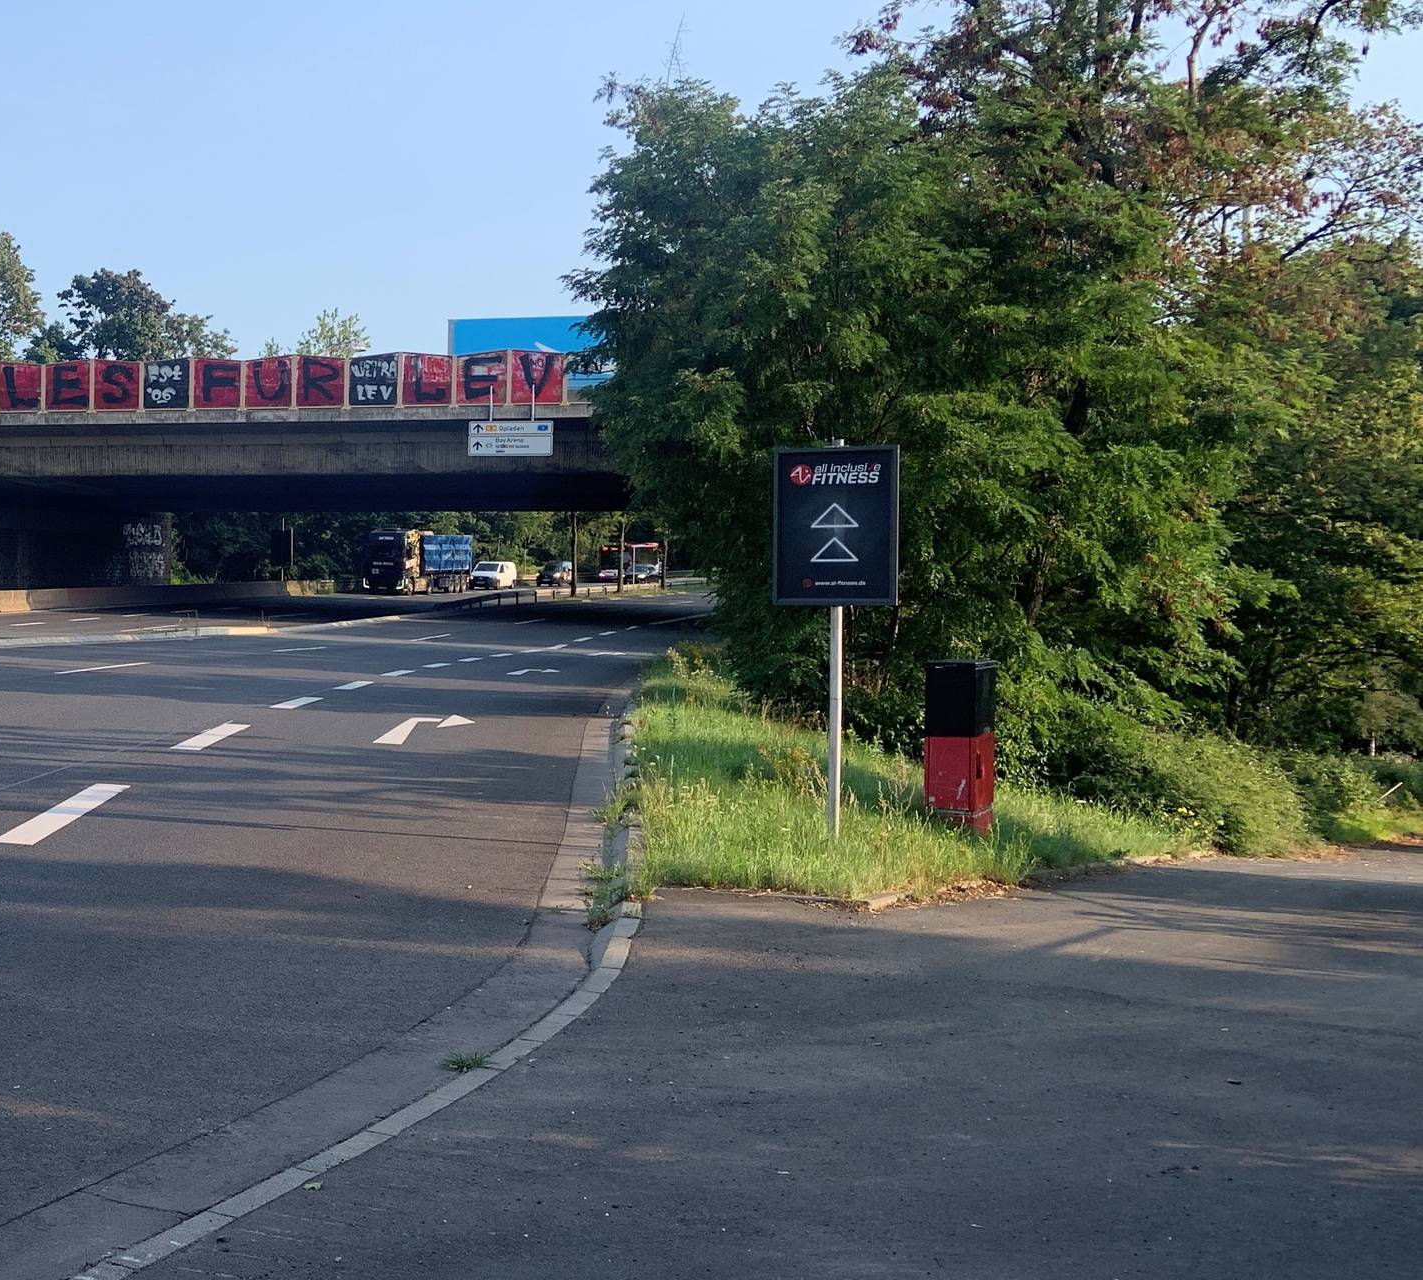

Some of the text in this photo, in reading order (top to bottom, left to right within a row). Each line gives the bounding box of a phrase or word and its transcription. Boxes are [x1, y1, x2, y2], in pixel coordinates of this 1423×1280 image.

[415, 352, 554, 402] LEV
[356, 384, 393, 401] LEV
[814, 463, 829, 473] all
[811, 471, 881, 485] FITNESS
